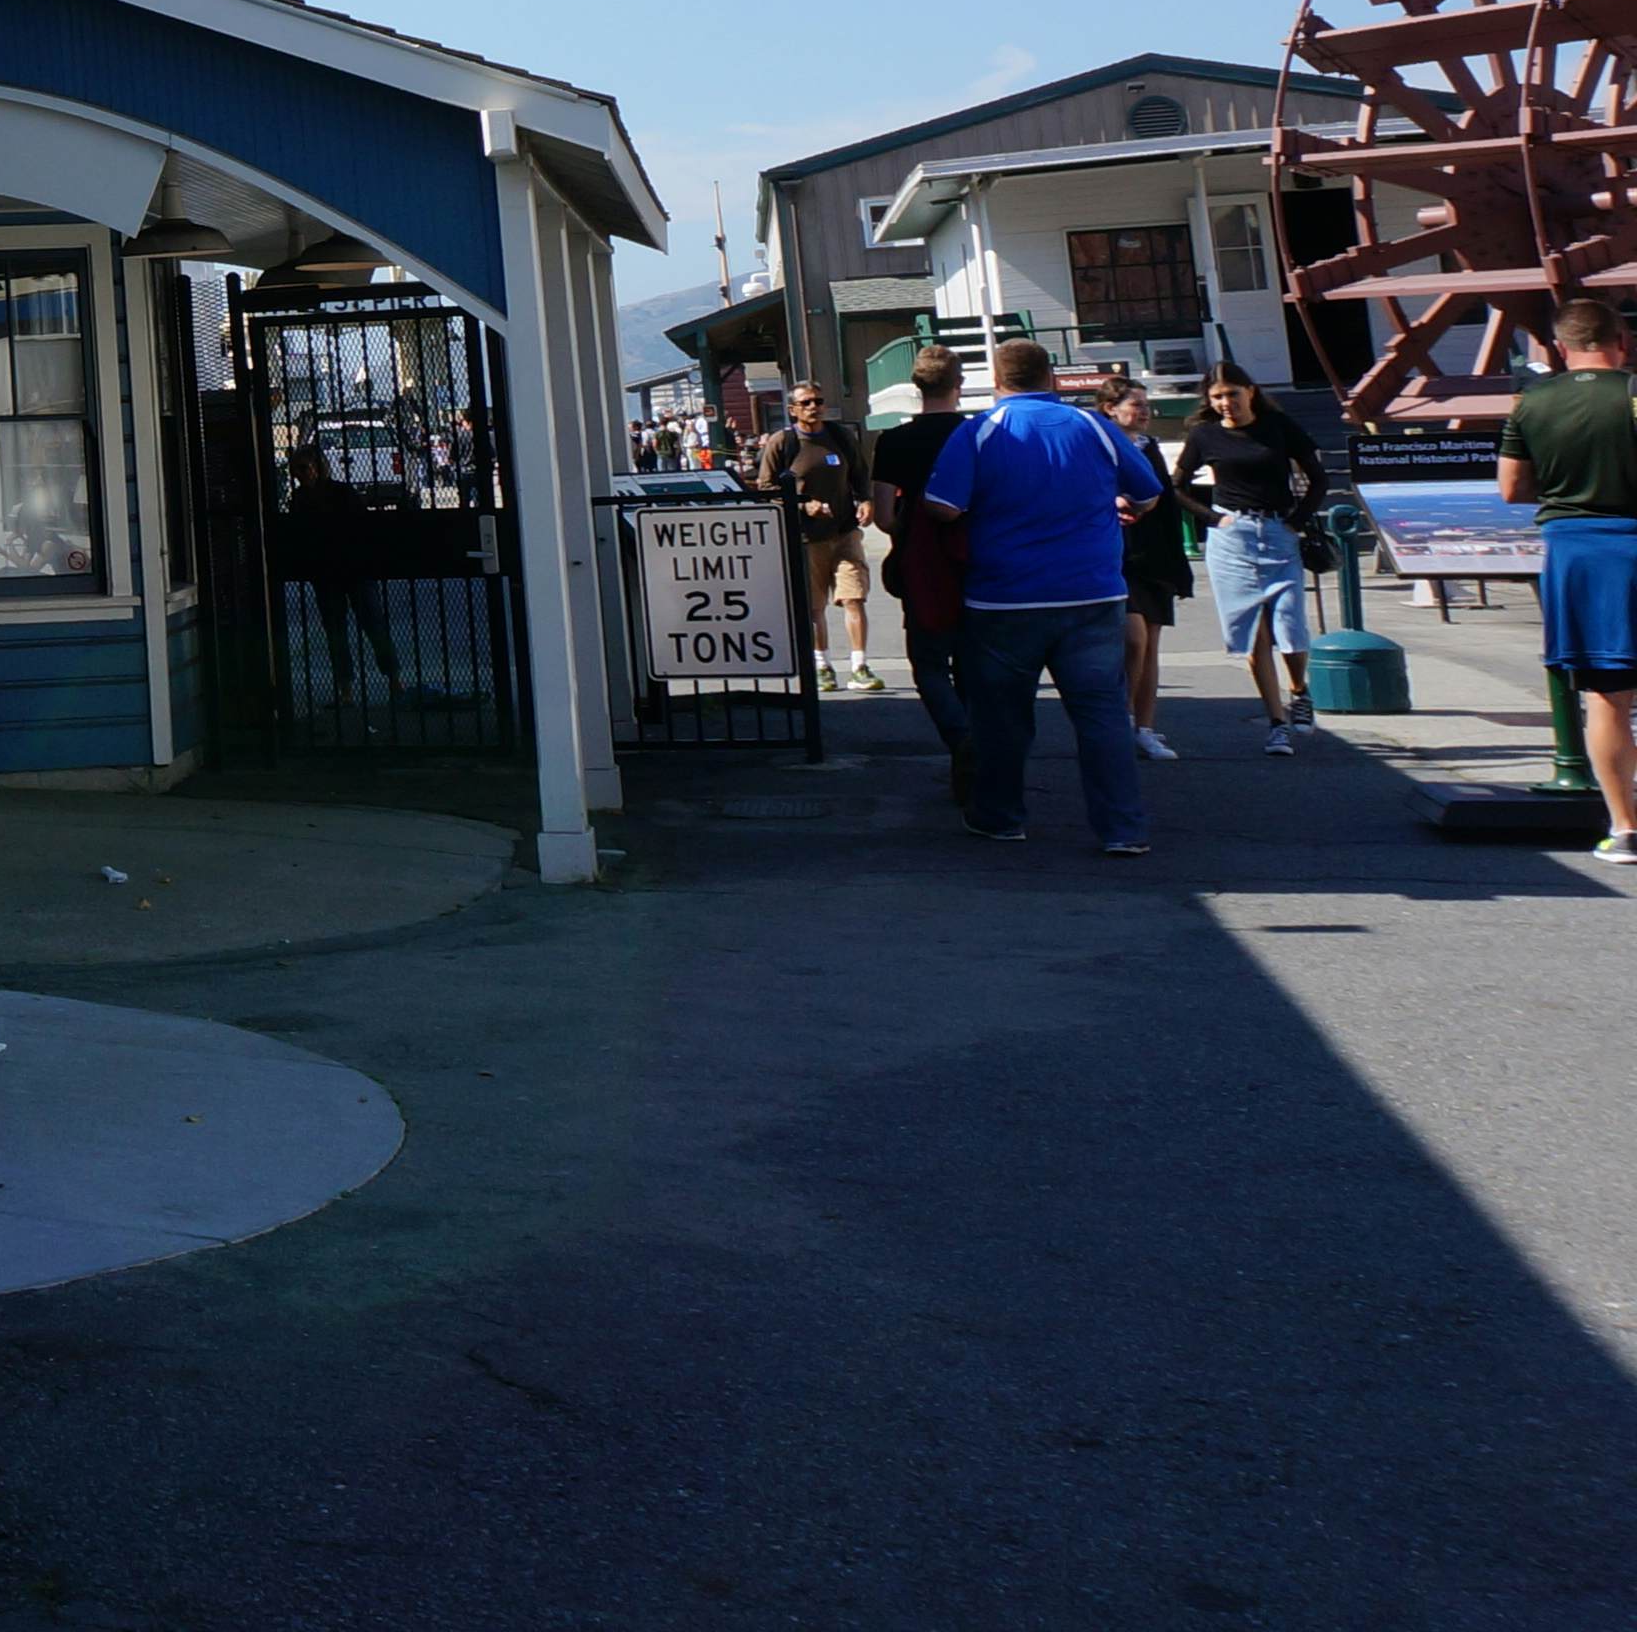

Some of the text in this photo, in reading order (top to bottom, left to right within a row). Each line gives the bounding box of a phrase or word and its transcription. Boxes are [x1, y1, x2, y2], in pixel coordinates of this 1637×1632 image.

[1357, 440, 1495, 452] San Francisco Maritime
[1358, 453, 1497, 465] National Historical Park
[653, 520, 769, 548] WEIGHT
[673, 555, 752, 581] LIMIT
[684, 590, 750, 622] 2.5
[668, 631, 775, 664] TONS
